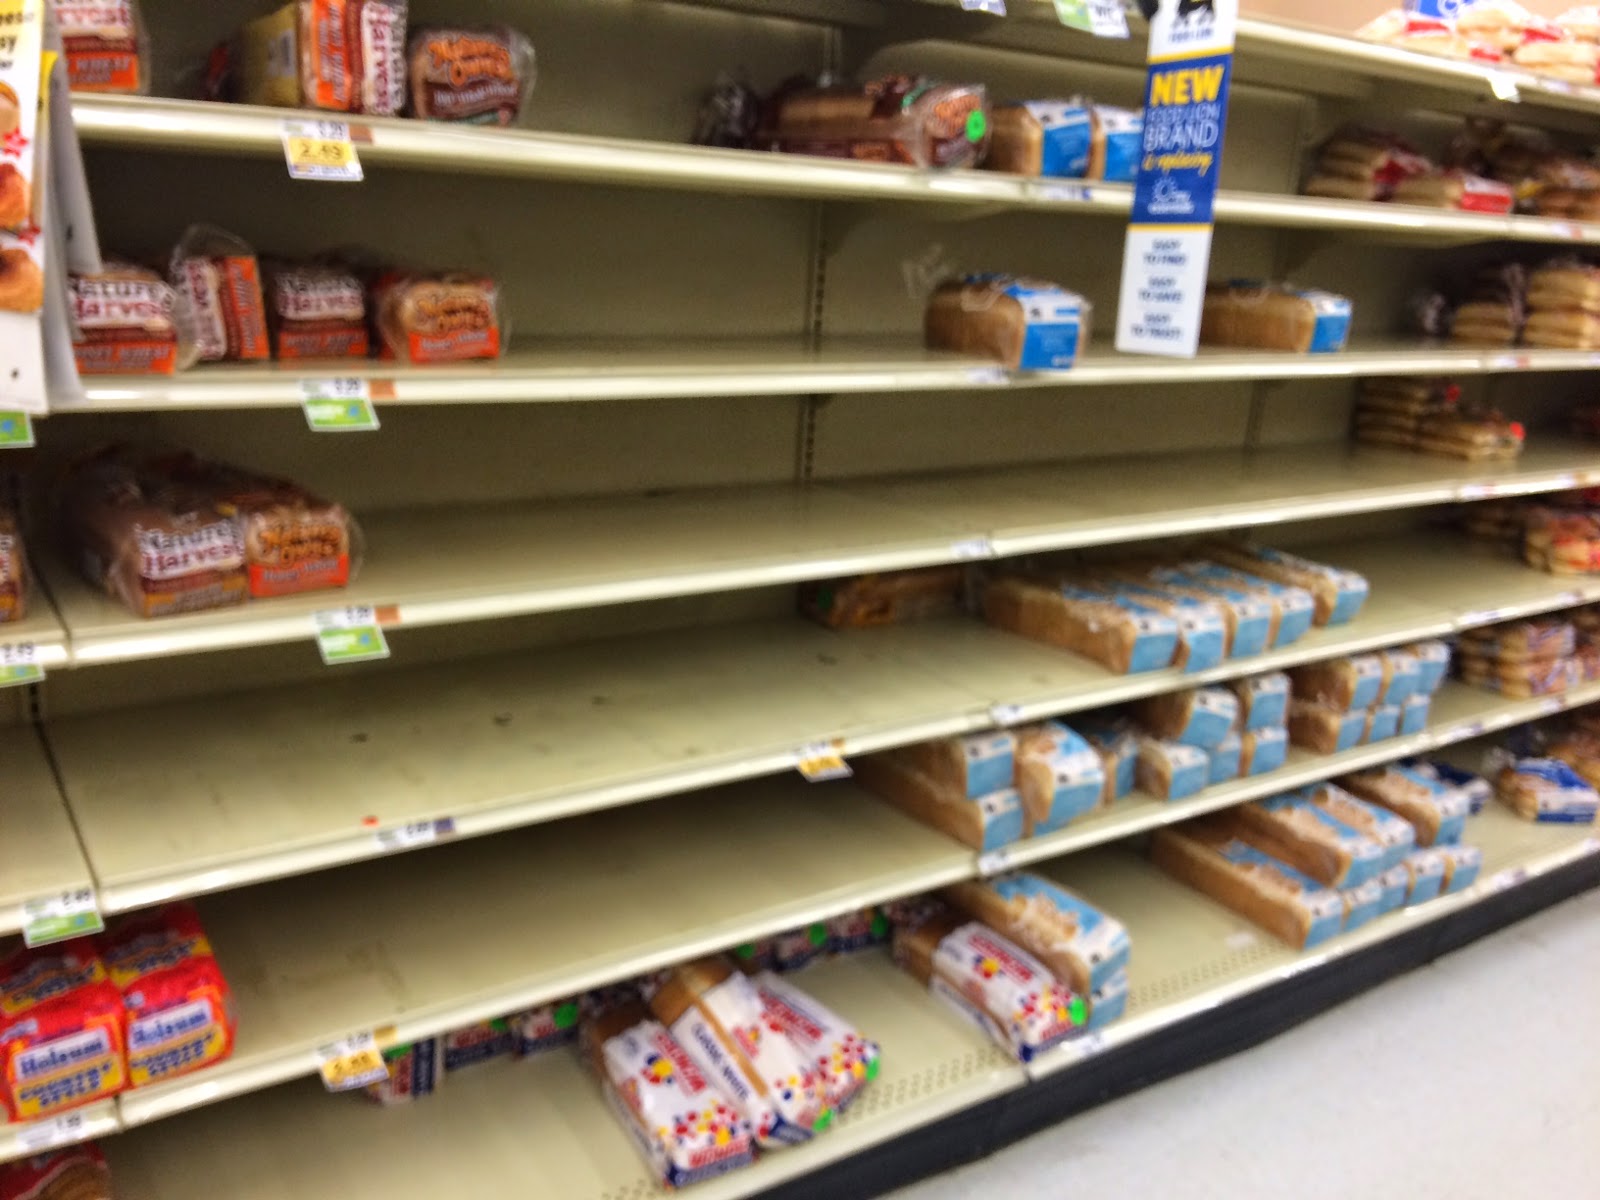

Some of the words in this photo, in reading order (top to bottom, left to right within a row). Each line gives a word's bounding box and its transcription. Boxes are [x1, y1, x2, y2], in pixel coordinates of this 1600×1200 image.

[1151, 64, 1225, 107] NEW
[1143, 118, 1219, 152] BRAND
[20, 1041, 103, 1077] Holsum
